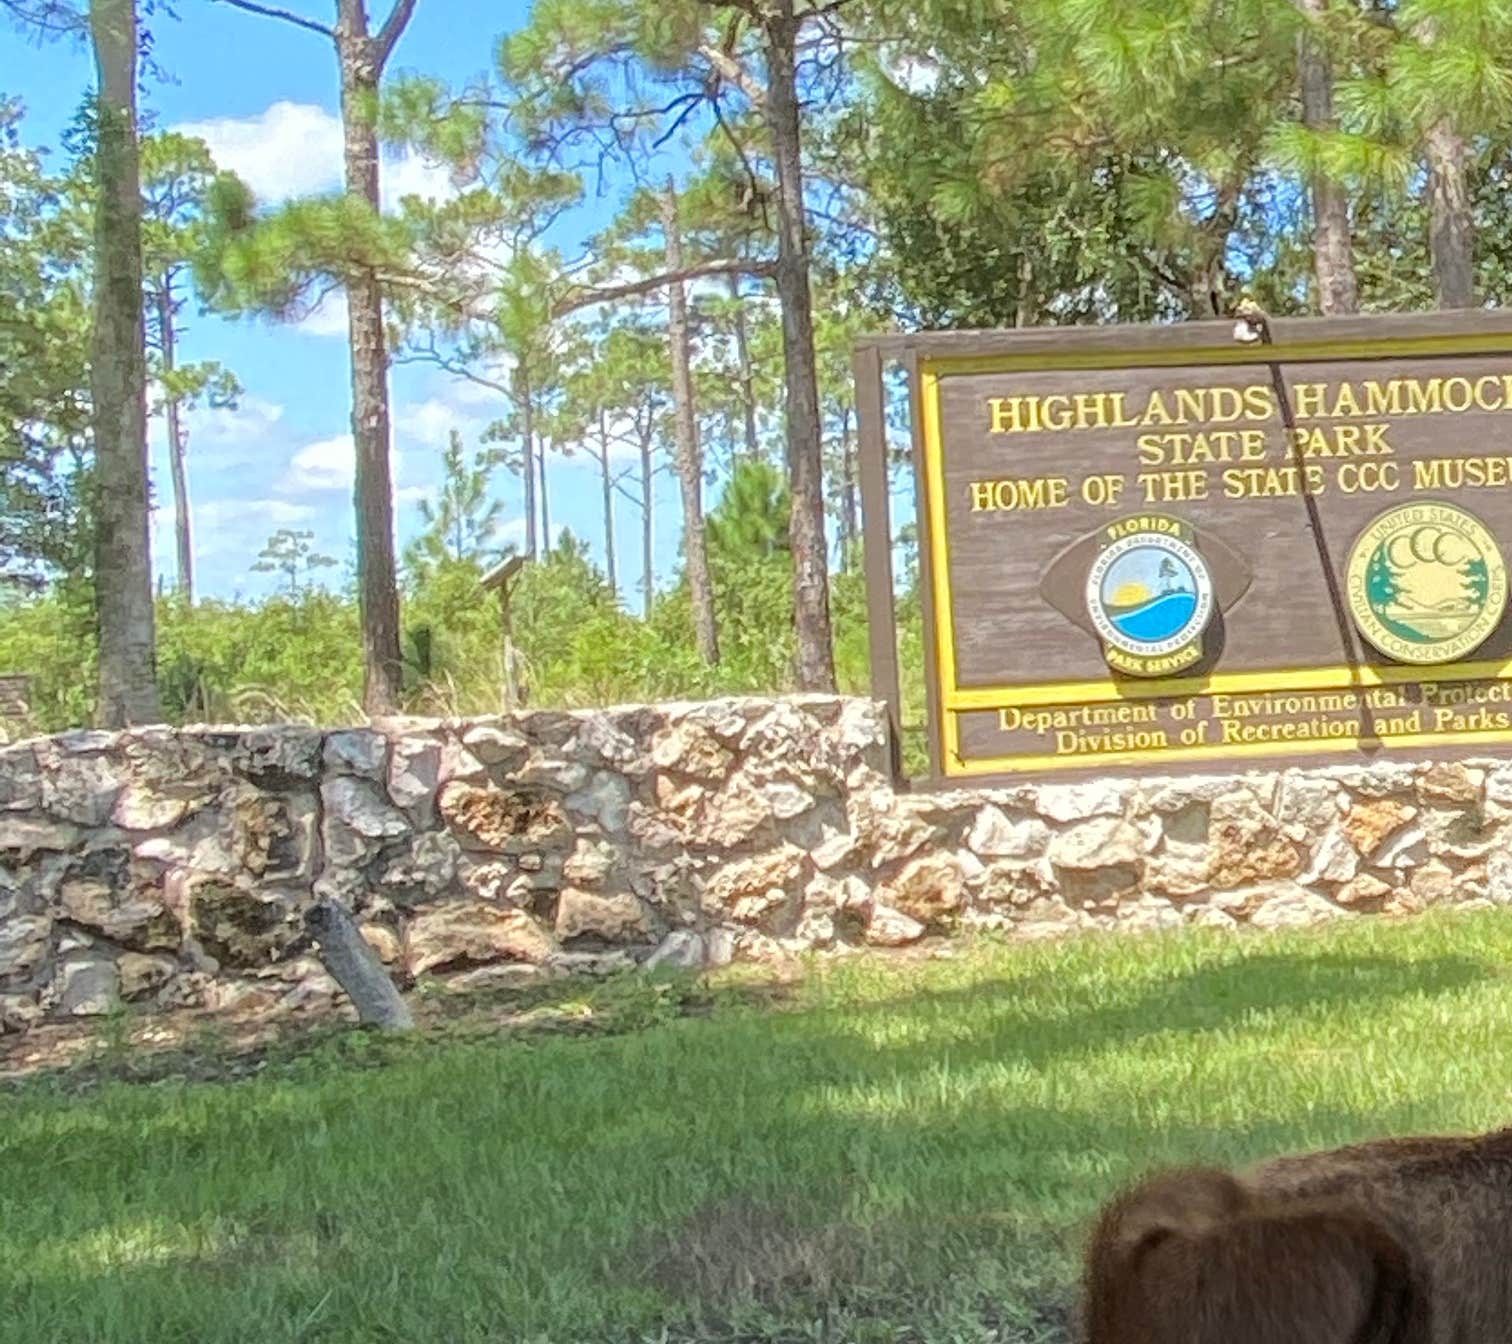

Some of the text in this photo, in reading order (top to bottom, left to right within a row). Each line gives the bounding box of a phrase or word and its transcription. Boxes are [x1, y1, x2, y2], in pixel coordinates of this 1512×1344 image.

[987, 386, 1274, 433] HIGHLANDS
[1136, 423, 1395, 465] STATE PARK
[969, 478, 1070, 512] HOME
[1081, 474, 1125, 505] OF
[1137, 470, 1209, 502] THE
[1223, 464, 1326, 499] STATE
[1337, 461, 1401, 493] CCC
[1107, 517, 1181, 540] FLORIDA
[1431, 509, 1478, 536] STATES
[1106, 645, 1199, 672] PARK SERVICE
[999, 705, 1157, 733] Department
[1170, 699, 1197, 721] of
[1056, 707, 1511, 754] Division of Recreation and Parks
